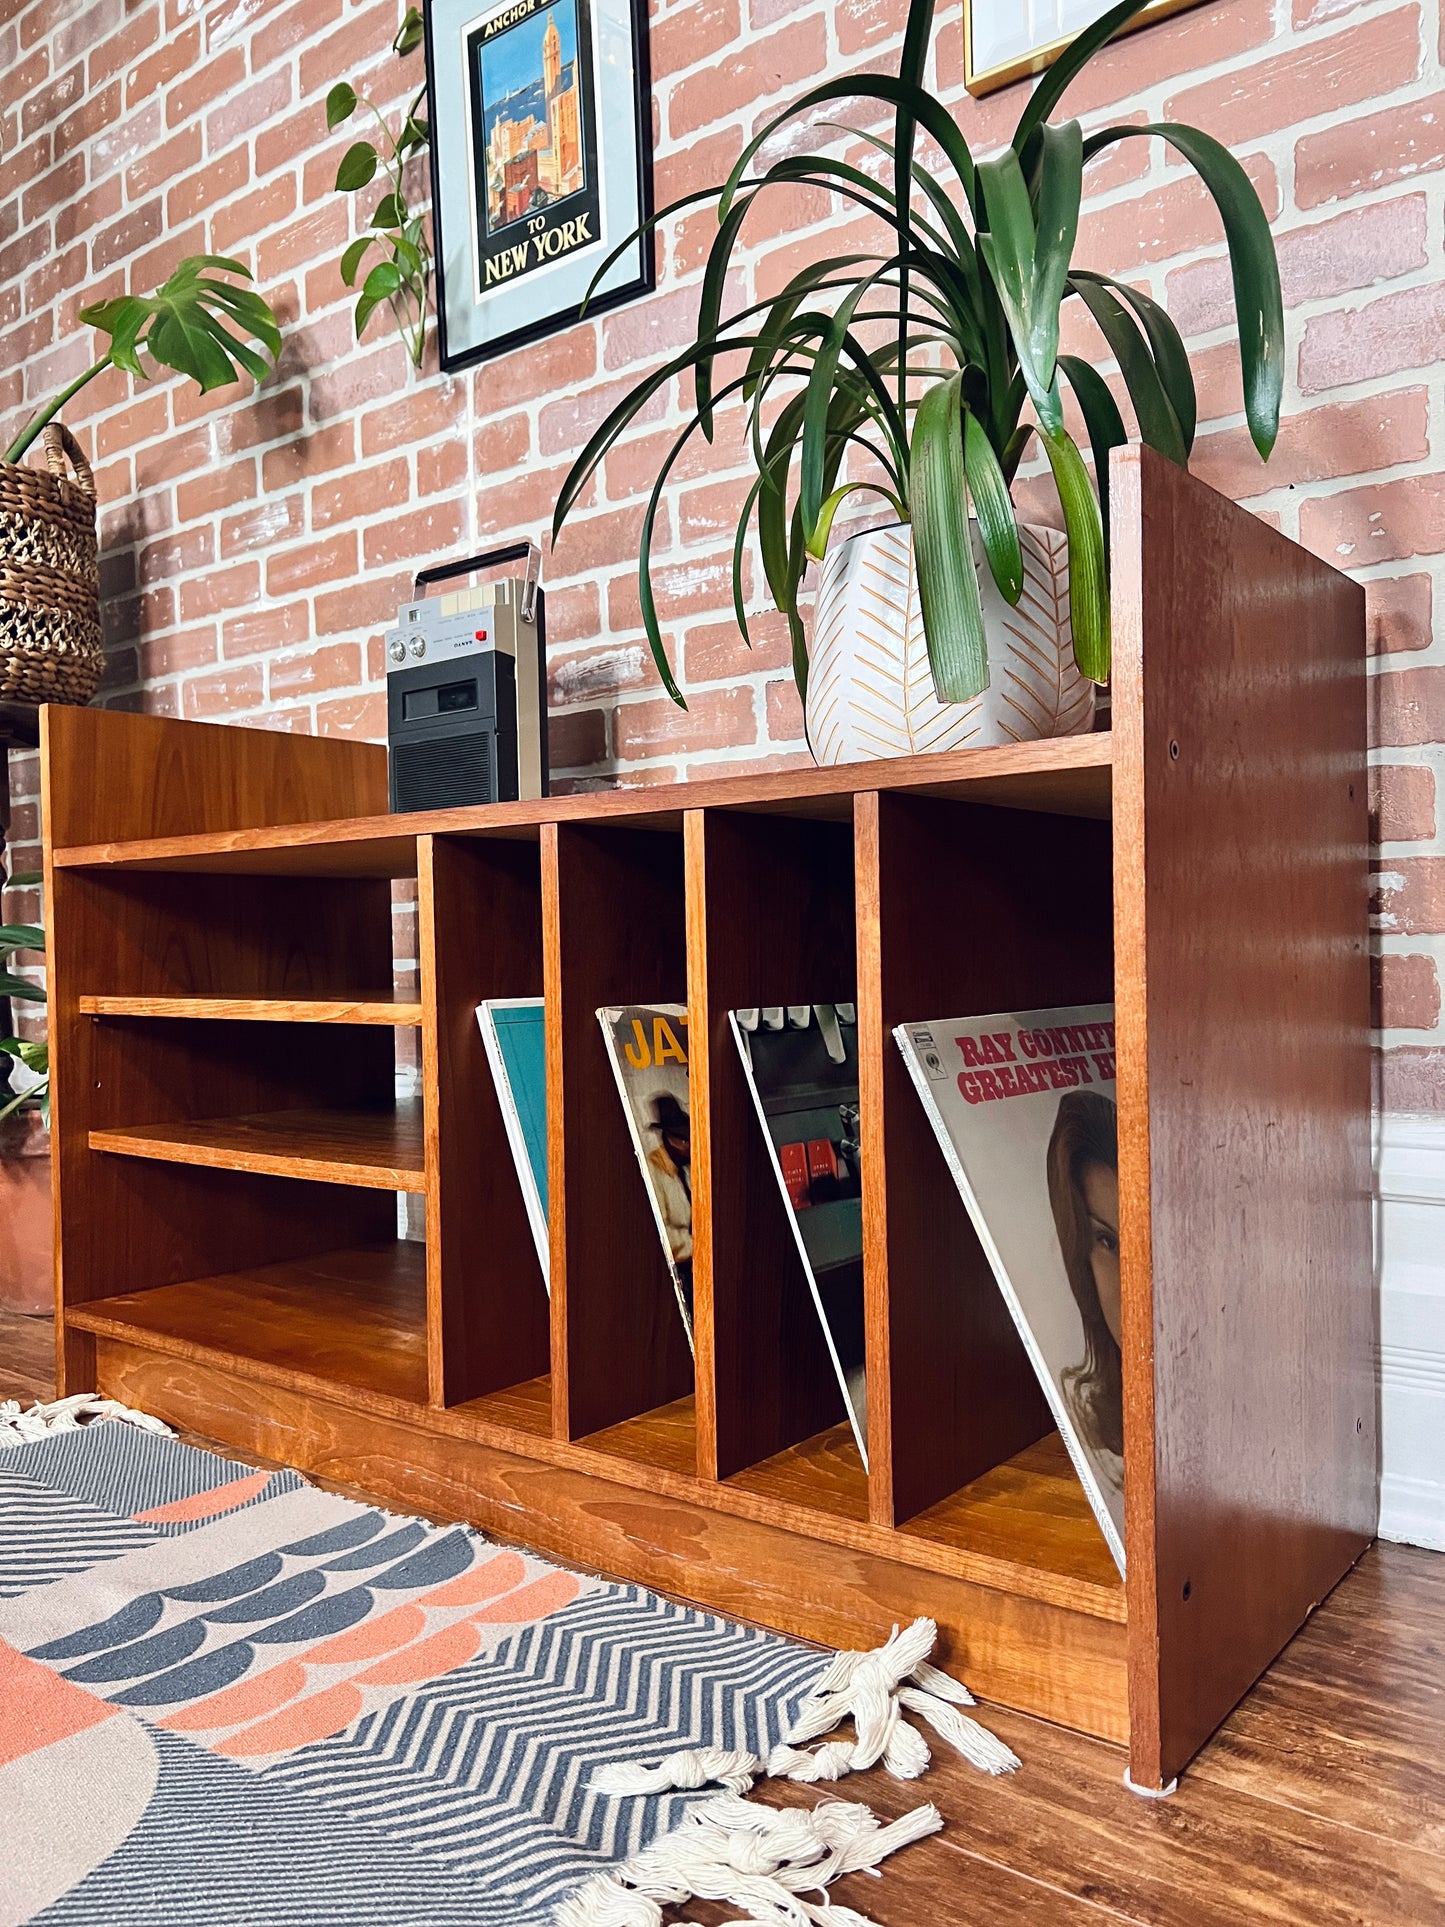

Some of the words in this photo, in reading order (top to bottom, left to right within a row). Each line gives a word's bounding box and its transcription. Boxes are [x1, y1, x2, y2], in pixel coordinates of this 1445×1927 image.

[484, 0, 535, 38] ANCHOR
[527, 215, 546, 235] TO
[484, 240, 530, 285] NEW
[532, 211, 593, 262] YORK
[624, 1015, 688, 1069] JA
[954, 1032, 1018, 1068] RAY
[956, 1056, 1094, 1105] GREATEST
